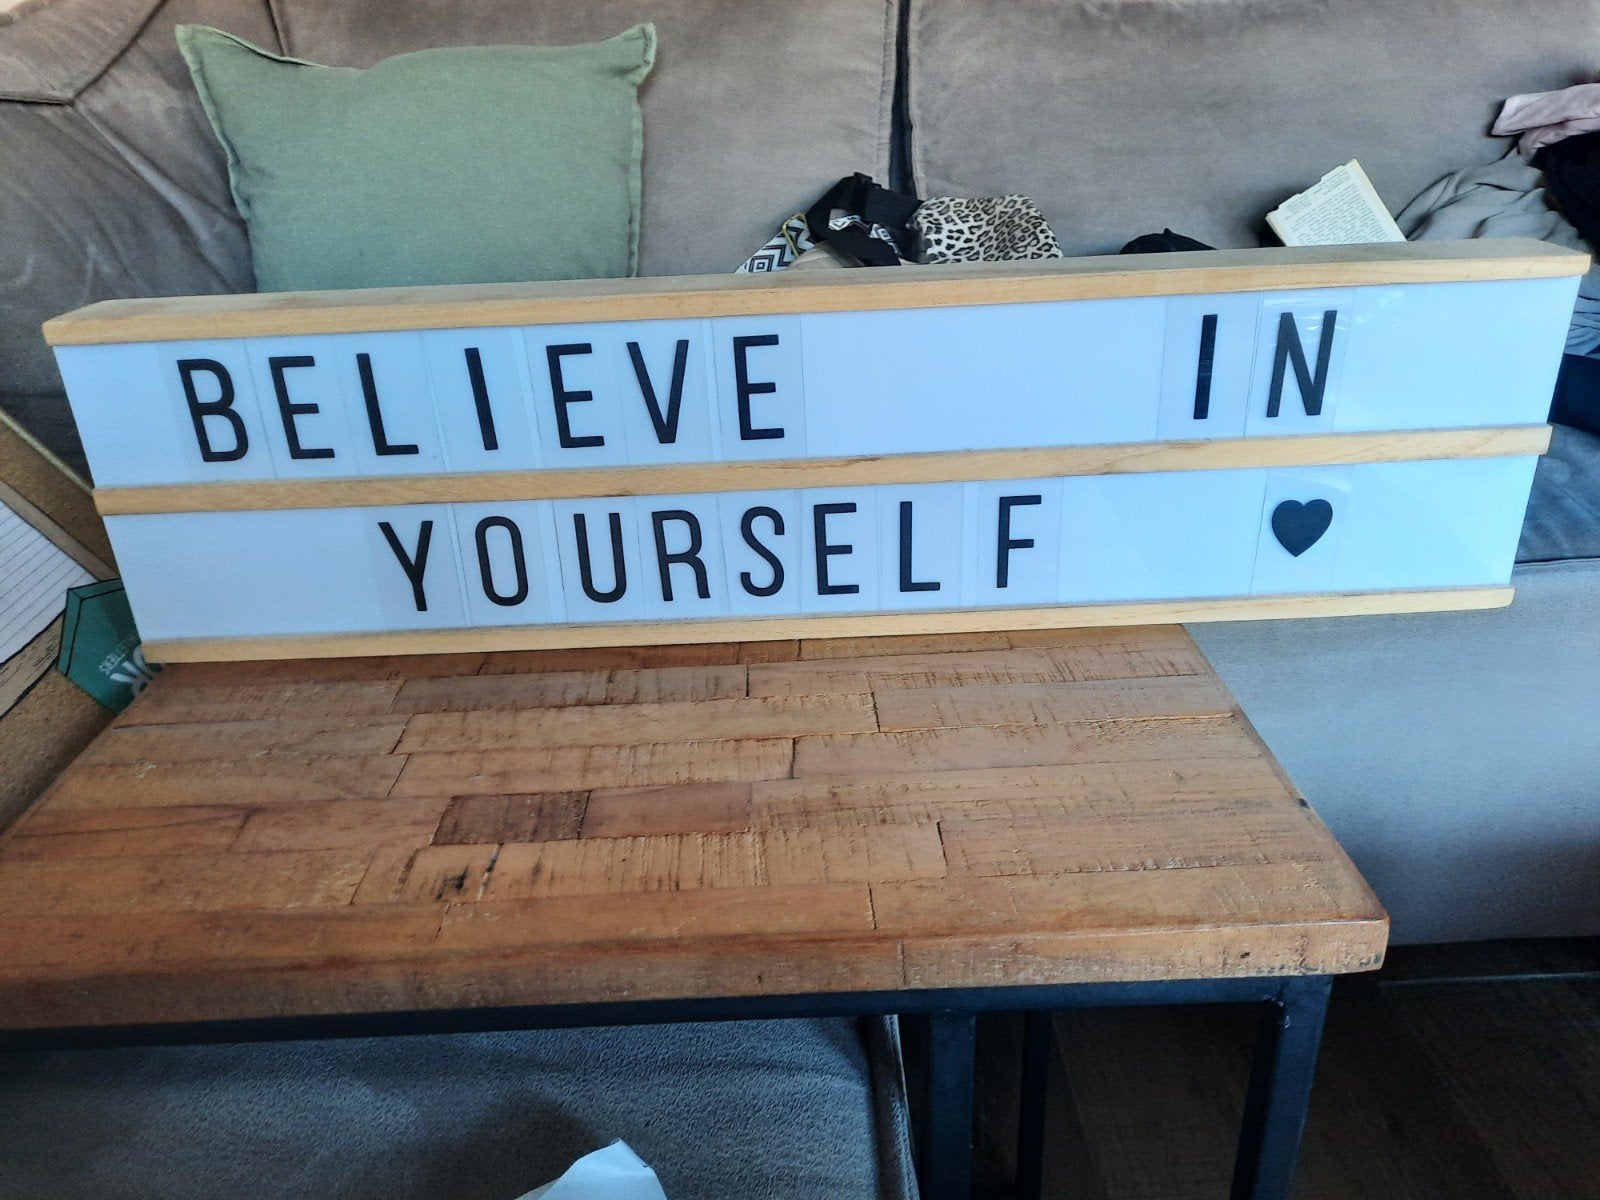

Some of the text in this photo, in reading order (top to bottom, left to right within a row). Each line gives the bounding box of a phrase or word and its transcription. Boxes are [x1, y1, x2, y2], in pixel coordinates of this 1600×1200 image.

[177, 310, 1338, 463] BELIEVE IN
[377, 494, 1042, 612] YOURSELF
